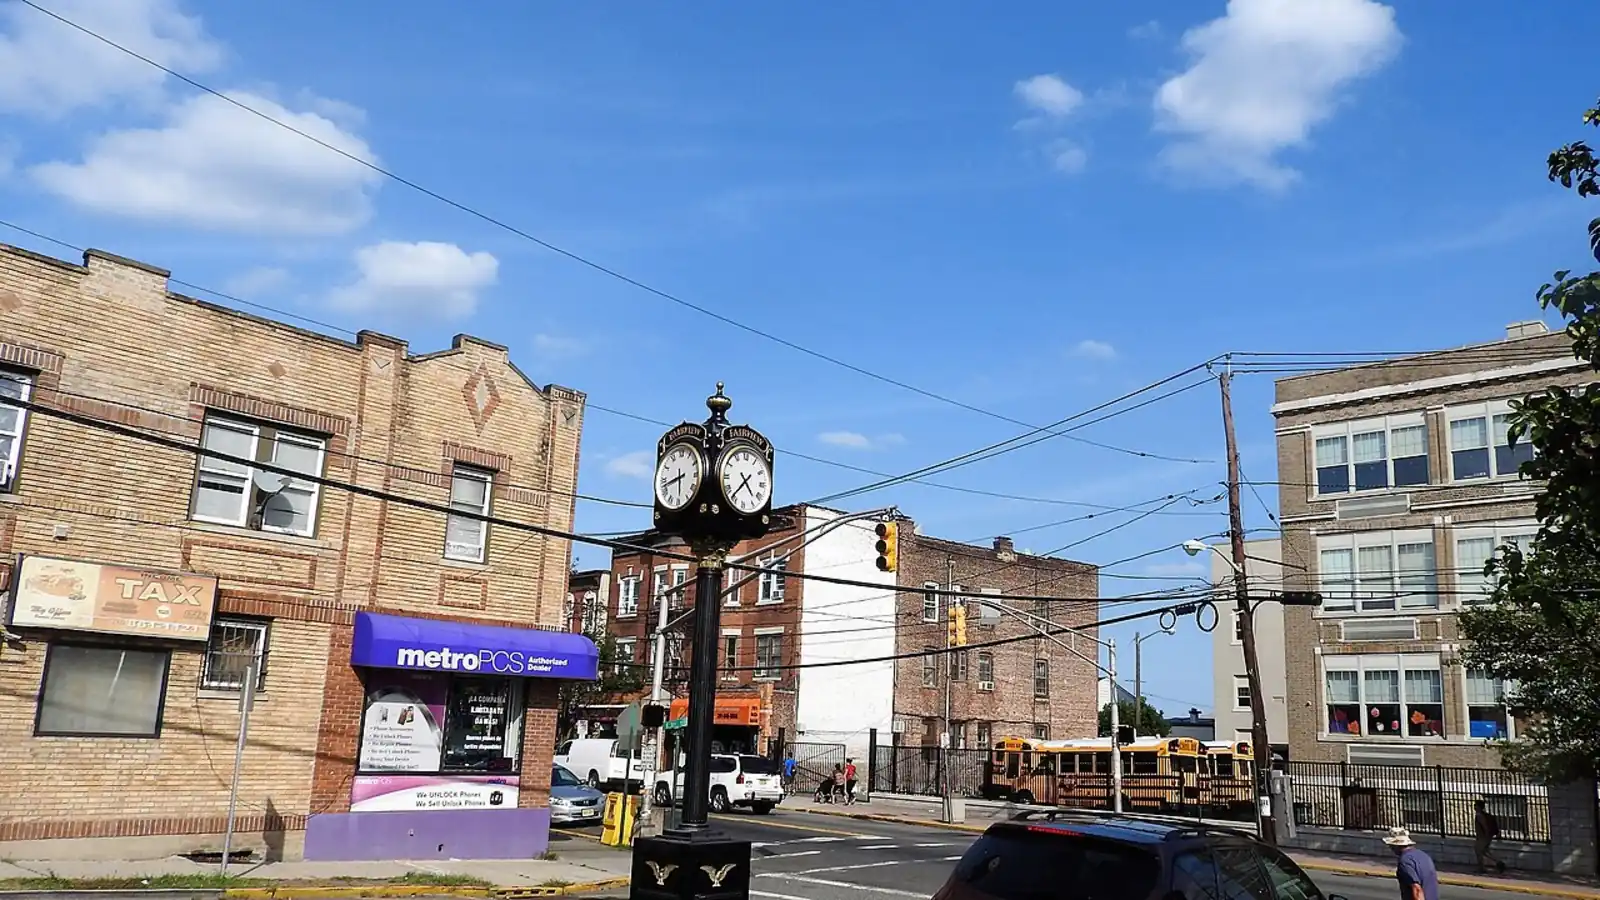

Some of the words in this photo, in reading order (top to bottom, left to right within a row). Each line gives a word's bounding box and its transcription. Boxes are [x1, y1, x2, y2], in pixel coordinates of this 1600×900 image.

[729, 428, 764, 445] FAIRVIEW
[115, 577, 203, 606] TAX
[397, 647, 524, 673] metroPCS
[528, 656, 568, 666] Authorized
[528, 664, 552, 672] Dealer
